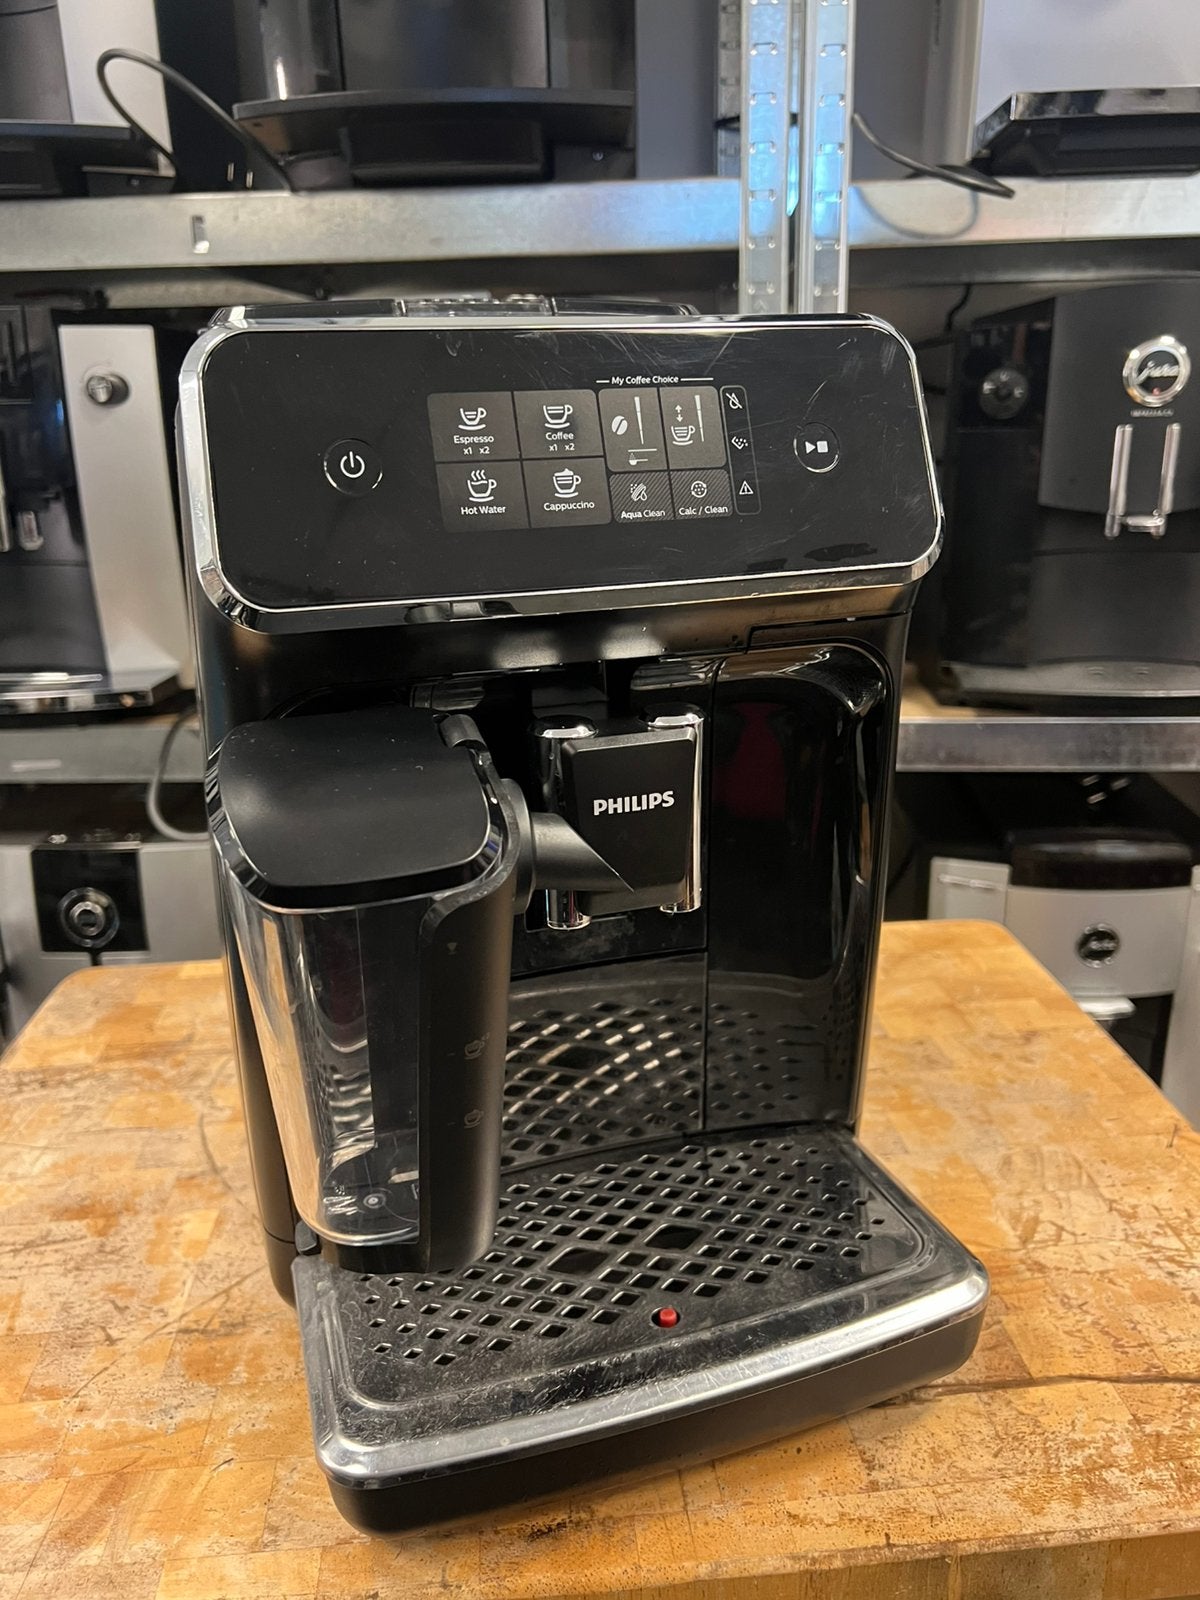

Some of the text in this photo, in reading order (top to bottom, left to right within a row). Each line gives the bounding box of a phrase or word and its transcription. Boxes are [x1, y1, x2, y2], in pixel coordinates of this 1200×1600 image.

[611, 375, 679, 386] My Coffee Choice
[453, 435, 494, 445] Espresso
[545, 431, 574, 441] Coffee
[463, 446, 490, 455] x1 x2
[549, 443, 575, 452] x1 x2
[460, 505, 506, 515] Hot Water
[543, 501, 595, 512] Cappuccino
[678, 507, 697, 515] Calc
[704, 506, 728, 514] Clean
[621, 509, 666, 520] Aqua Clean
[593, 790, 675, 816] PHILIPS
